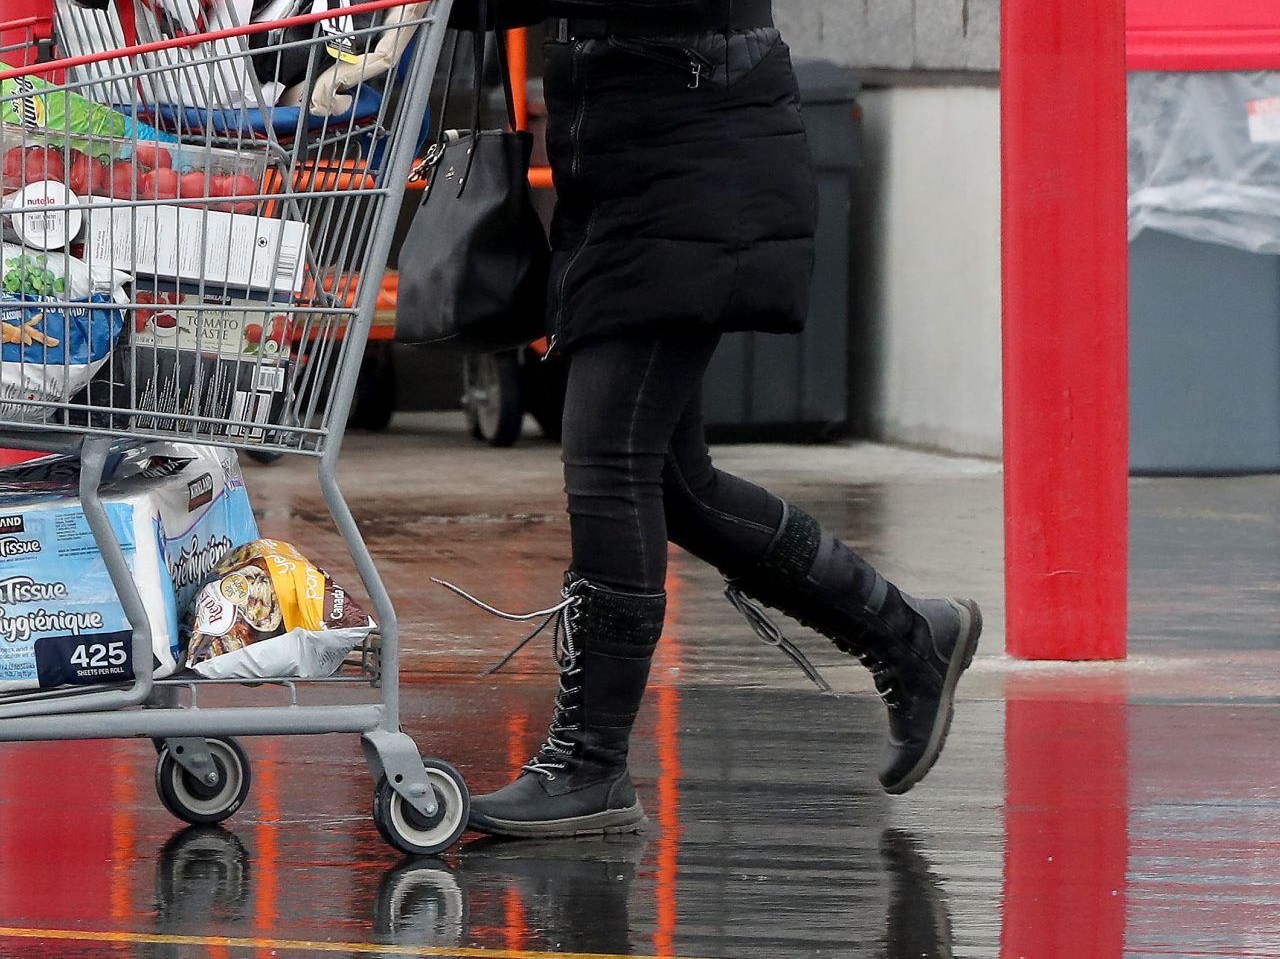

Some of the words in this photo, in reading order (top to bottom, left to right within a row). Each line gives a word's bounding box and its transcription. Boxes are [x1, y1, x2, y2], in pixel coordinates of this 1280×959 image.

[27, 196, 56, 206] nutela
[203, 293, 231, 302] IRKLAD
[186, 315, 239, 331] TOMATO
[330, 589, 345, 620] Canada
[70, 641, 127, 668] 425
[109, 666, 125, 674] ROLL
